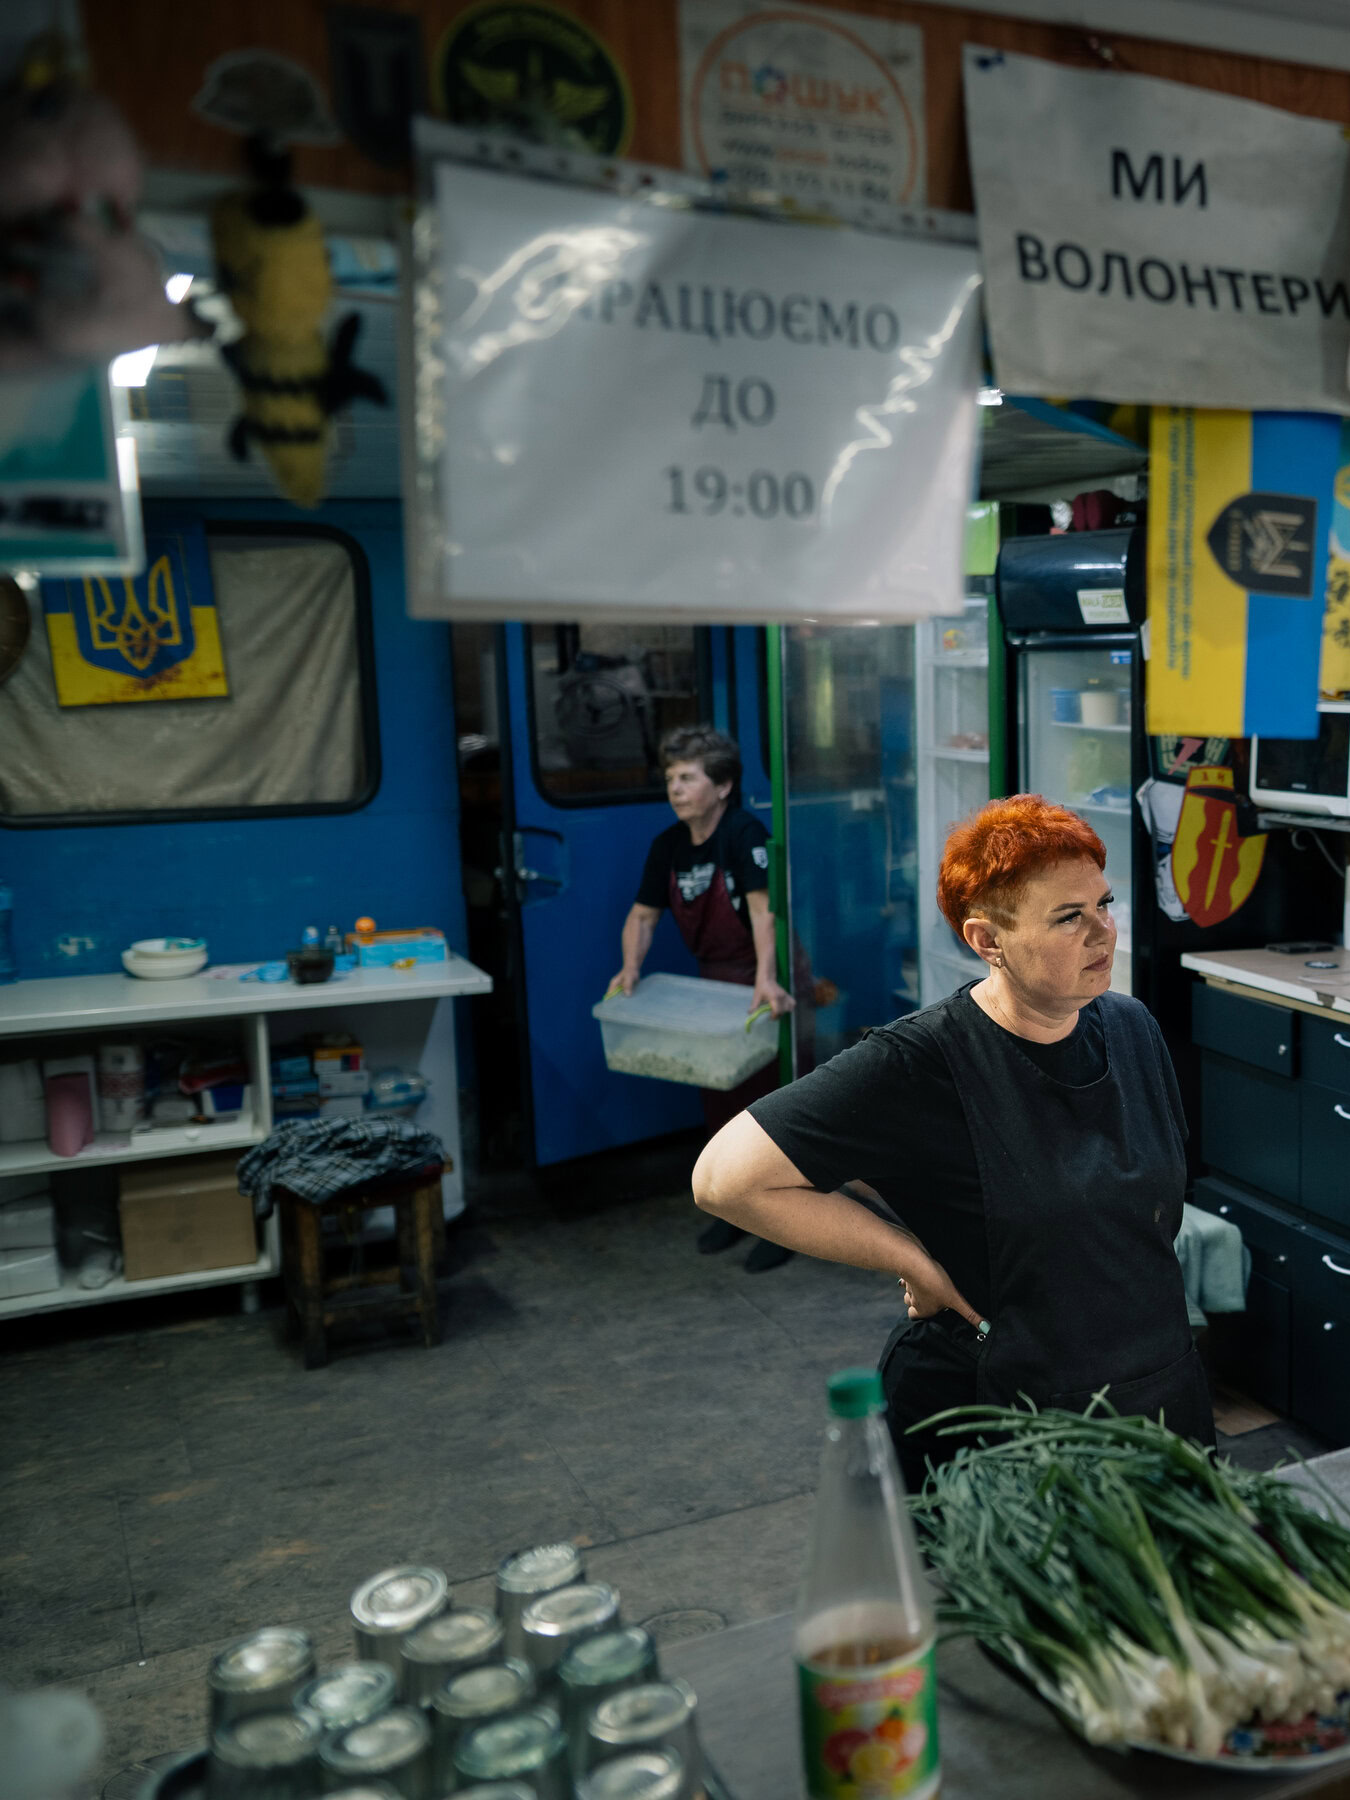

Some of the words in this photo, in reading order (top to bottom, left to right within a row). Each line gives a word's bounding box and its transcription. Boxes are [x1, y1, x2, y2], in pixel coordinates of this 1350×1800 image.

[1109, 147, 1207, 210] МИ
[579, 275, 900, 353] РАЦЮЄМО
[689, 372, 777, 434] ДО
[661, 462, 817, 522] 19:00
